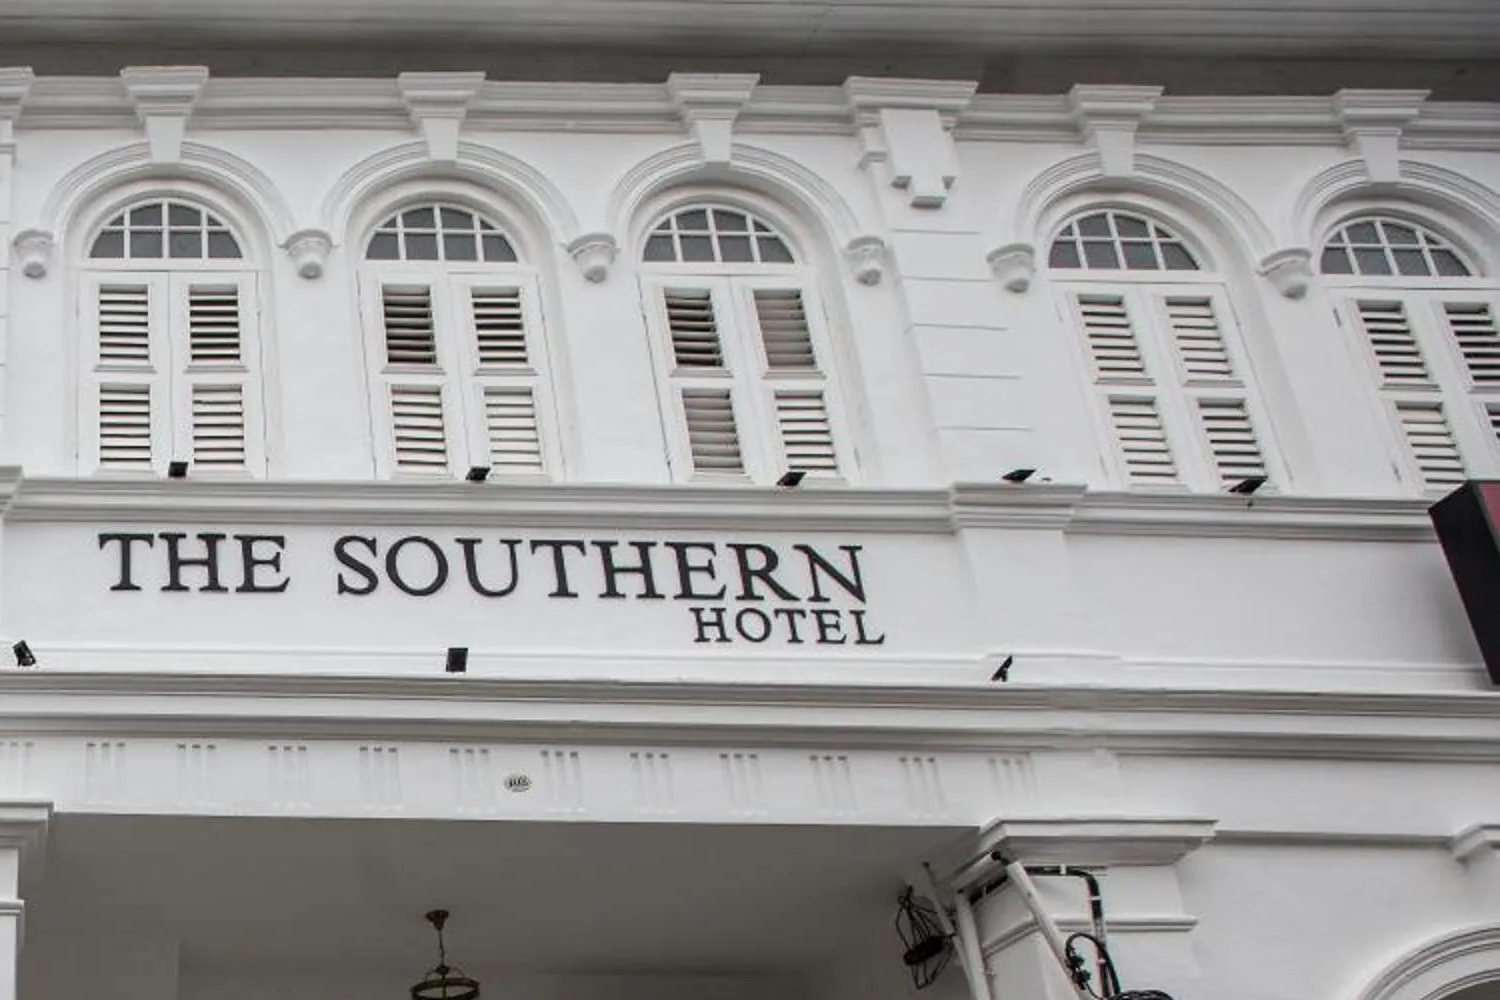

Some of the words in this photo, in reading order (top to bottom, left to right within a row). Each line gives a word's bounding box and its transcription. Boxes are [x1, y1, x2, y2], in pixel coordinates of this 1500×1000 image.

[97, 532, 291, 594] THE
[332, 535, 871, 604] SOUTHERN
[693, 607, 886, 647] HOTEL
